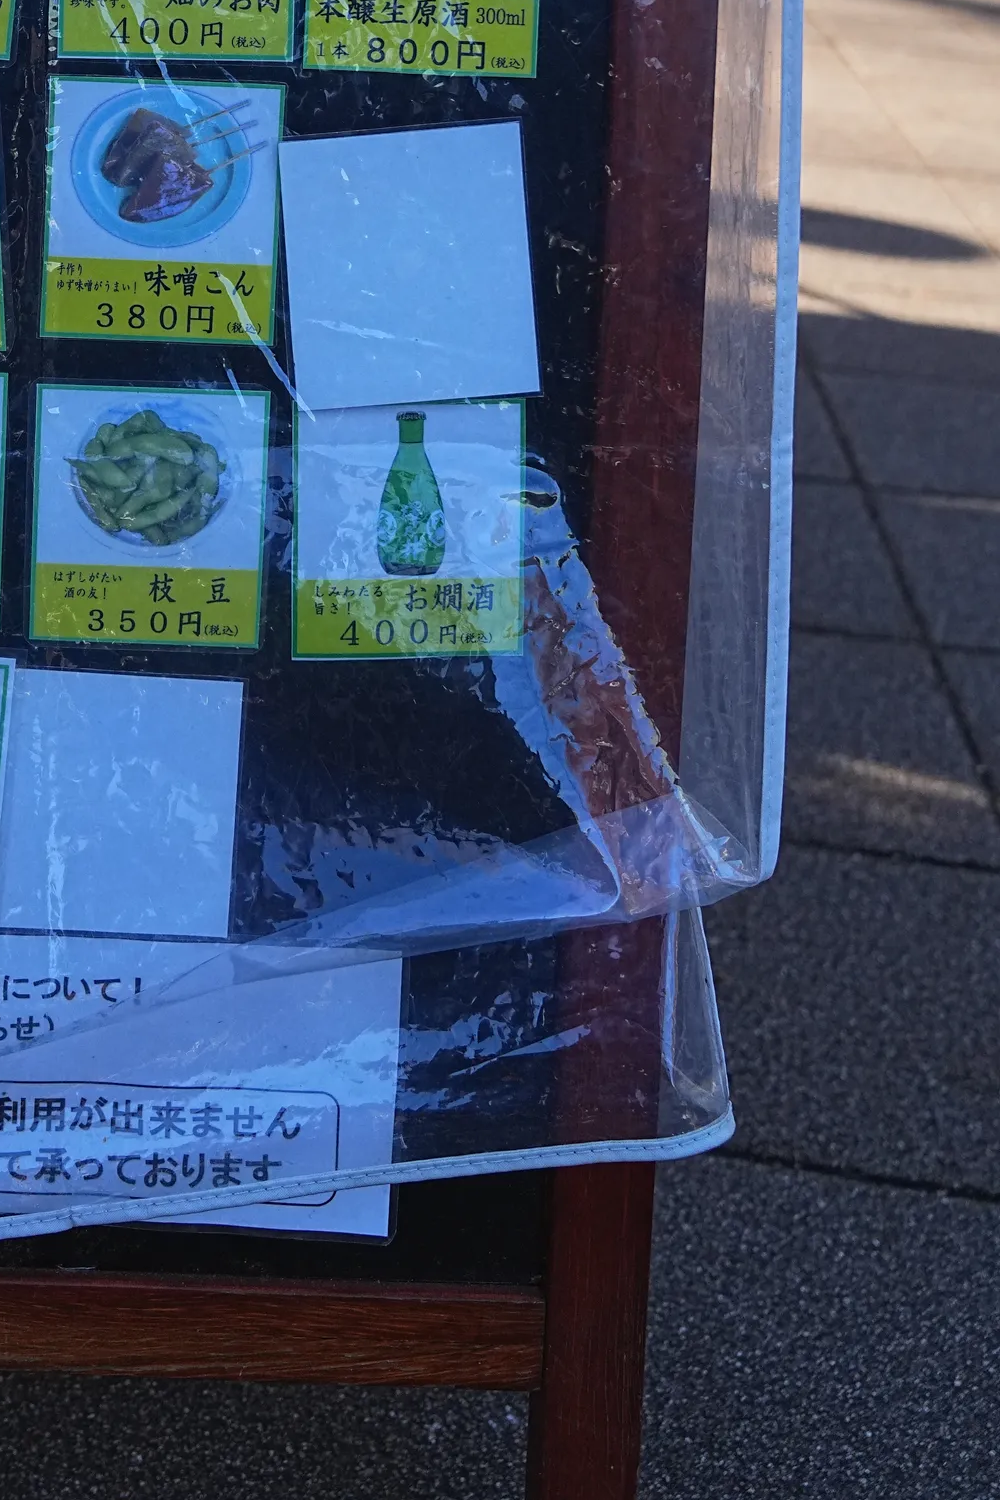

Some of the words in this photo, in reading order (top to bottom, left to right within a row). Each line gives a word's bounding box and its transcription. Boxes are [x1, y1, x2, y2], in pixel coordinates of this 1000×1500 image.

[476, 7, 526, 26] 300ml
[110, 17, 223, 48] 400円
[231, 36, 266, 49] (税込)
[316, 41, 350, 60] 1本
[366, 37, 486, 70] 800円
[491, 58, 526, 70] (税込)
[57, 262, 83, 275] 手作り
[144, 264, 254, 297] 味噌こん
[96, 302, 215, 334] 380円
[53, 571, 122, 583] はずしがたい
[149, 573, 231, 604] 枝豆
[64, 586, 108, 600] 酒の友！
[315, 585, 383, 598] しみわたる
[88, 609, 202, 637] 350円
[204, 624, 239, 637] (税込)
[340, 619, 457, 646] 400円
